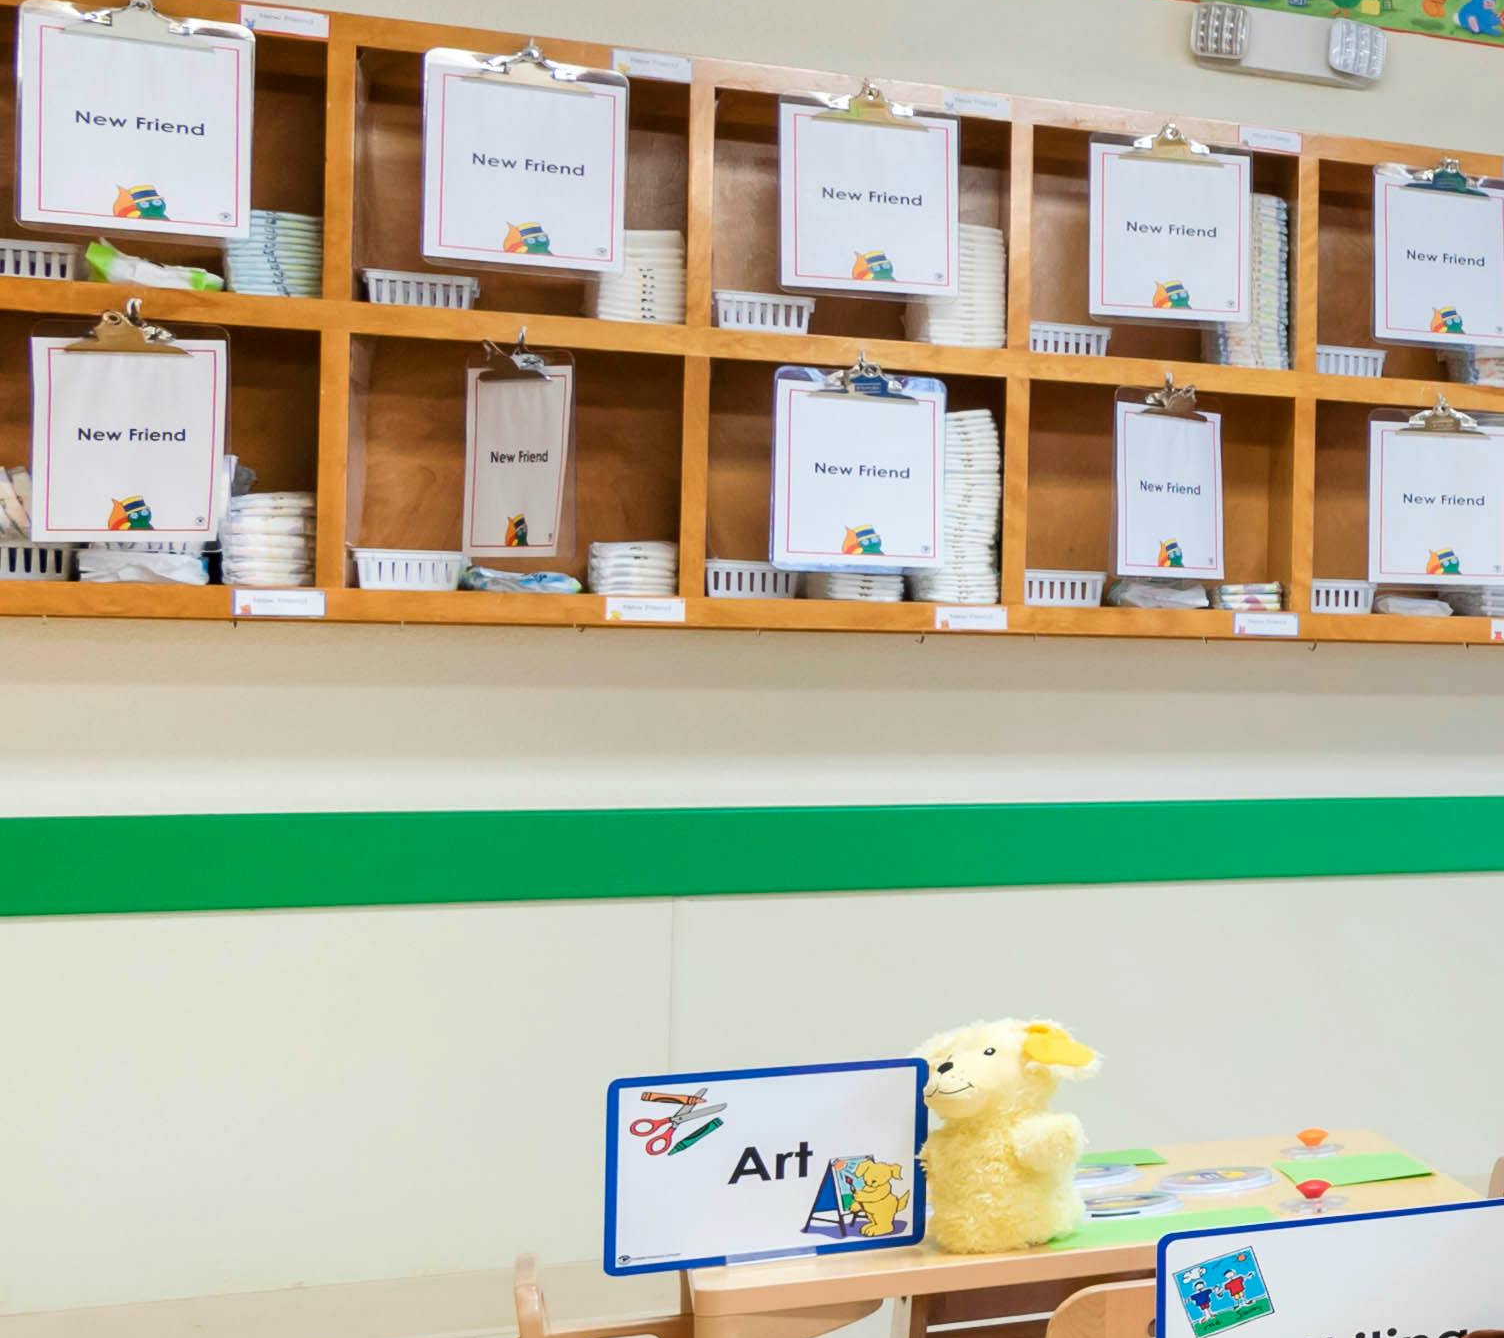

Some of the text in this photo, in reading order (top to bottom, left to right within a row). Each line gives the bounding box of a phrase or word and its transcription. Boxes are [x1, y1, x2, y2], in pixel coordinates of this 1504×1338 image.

[76, 111, 204, 135] New Friend
[473, 153, 584, 176] New Friend
[823, 187, 921, 205] New Friend
[1127, 221, 1216, 237] New Friend
[1407, 250, 1484, 266] New Friend
[78, 428, 185, 441] New Friend
[491, 451, 548, 463] New Friend
[815, 463, 909, 478] New Friend
[1140, 481, 1200, 495] New Friend
[1404, 494, 1484, 505] New Friend
[728, 1142, 813, 1184] Art
